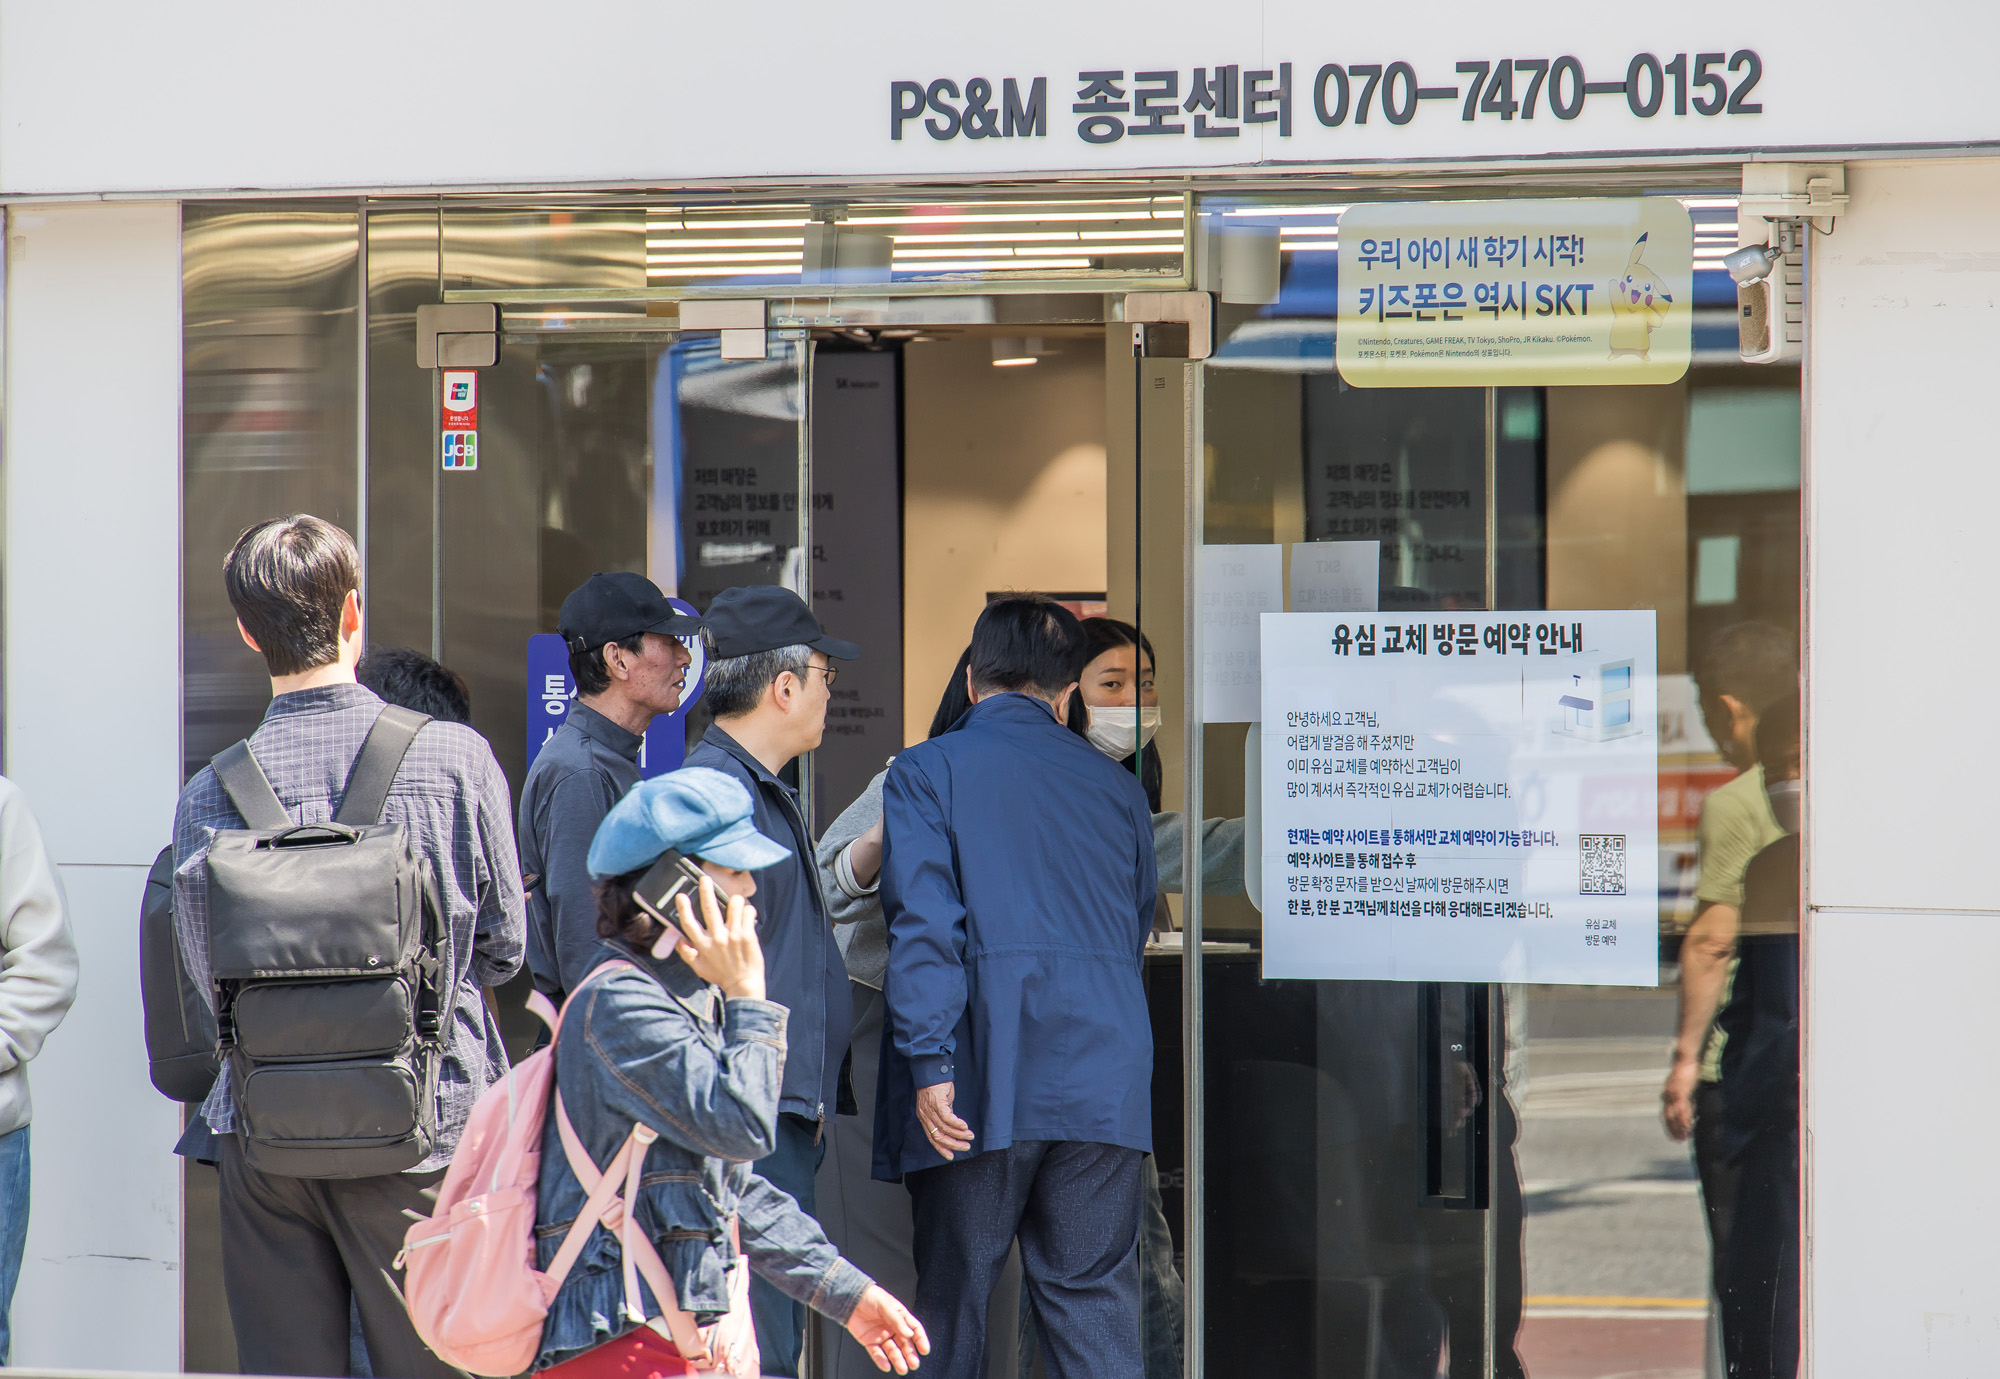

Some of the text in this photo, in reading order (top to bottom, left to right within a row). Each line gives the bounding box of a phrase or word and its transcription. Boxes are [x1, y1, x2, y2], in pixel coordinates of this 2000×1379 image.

[890, 50, 1763, 145] PS&M 종로센터 070-7470-0152
[1358, 234, 1585, 271] 우리 아이 새 학기 시작!
[1359, 281, 1595, 323] 키즈폰은 역시 SKT
[1393, 337, 1425, 346] Creatures,
[1425, 337, 1443, 345] GAME
[1444, 337, 1466, 345] FREAK,
[1467, 337, 1475, 345] TV
[1476, 336, 1497, 346] Tokyo,
[1498, 336, 1522, 345] ShoPro,
[1523, 336, 1531, 344] JR
[1532, 335, 1555, 344] Kikaku.
[1481, 349, 1513, 358] 상표입니다.
[443, 444, 475, 457] JCB
[1332, 623, 1583, 656] 유심 교체 방문 예약 안내
[1287, 711, 1380, 729] 안녕하세요 고객님,
[1287, 734, 1415, 751] 어렵게 발걸음 해 주셨지만
[1287, 758, 1461, 775] 이미 유심 교체를 예약하신 고객님이
[1287, 781, 1512, 798] 많이 계셔서 즉각적인 유심 교체가 어렵습니다.
[1287, 828, 1559, 847] 현재는 예약 사이트를 통해서만 교체 예약이 가능합니다.
[1287, 852, 1417, 869] 예약 사이트를 통해 접수 후
[1287, 875, 1510, 893] 방문 확정 문자를 받으신 날짜에 방문해주시면
[1287, 899, 1554, 919] 한 분, 한 분 고객님께 최선을 다해 응대해드리겠습니다.
[1585, 918, 1617, 930] 유심 교체
[1585, 934, 1617, 946] 방문 예약
